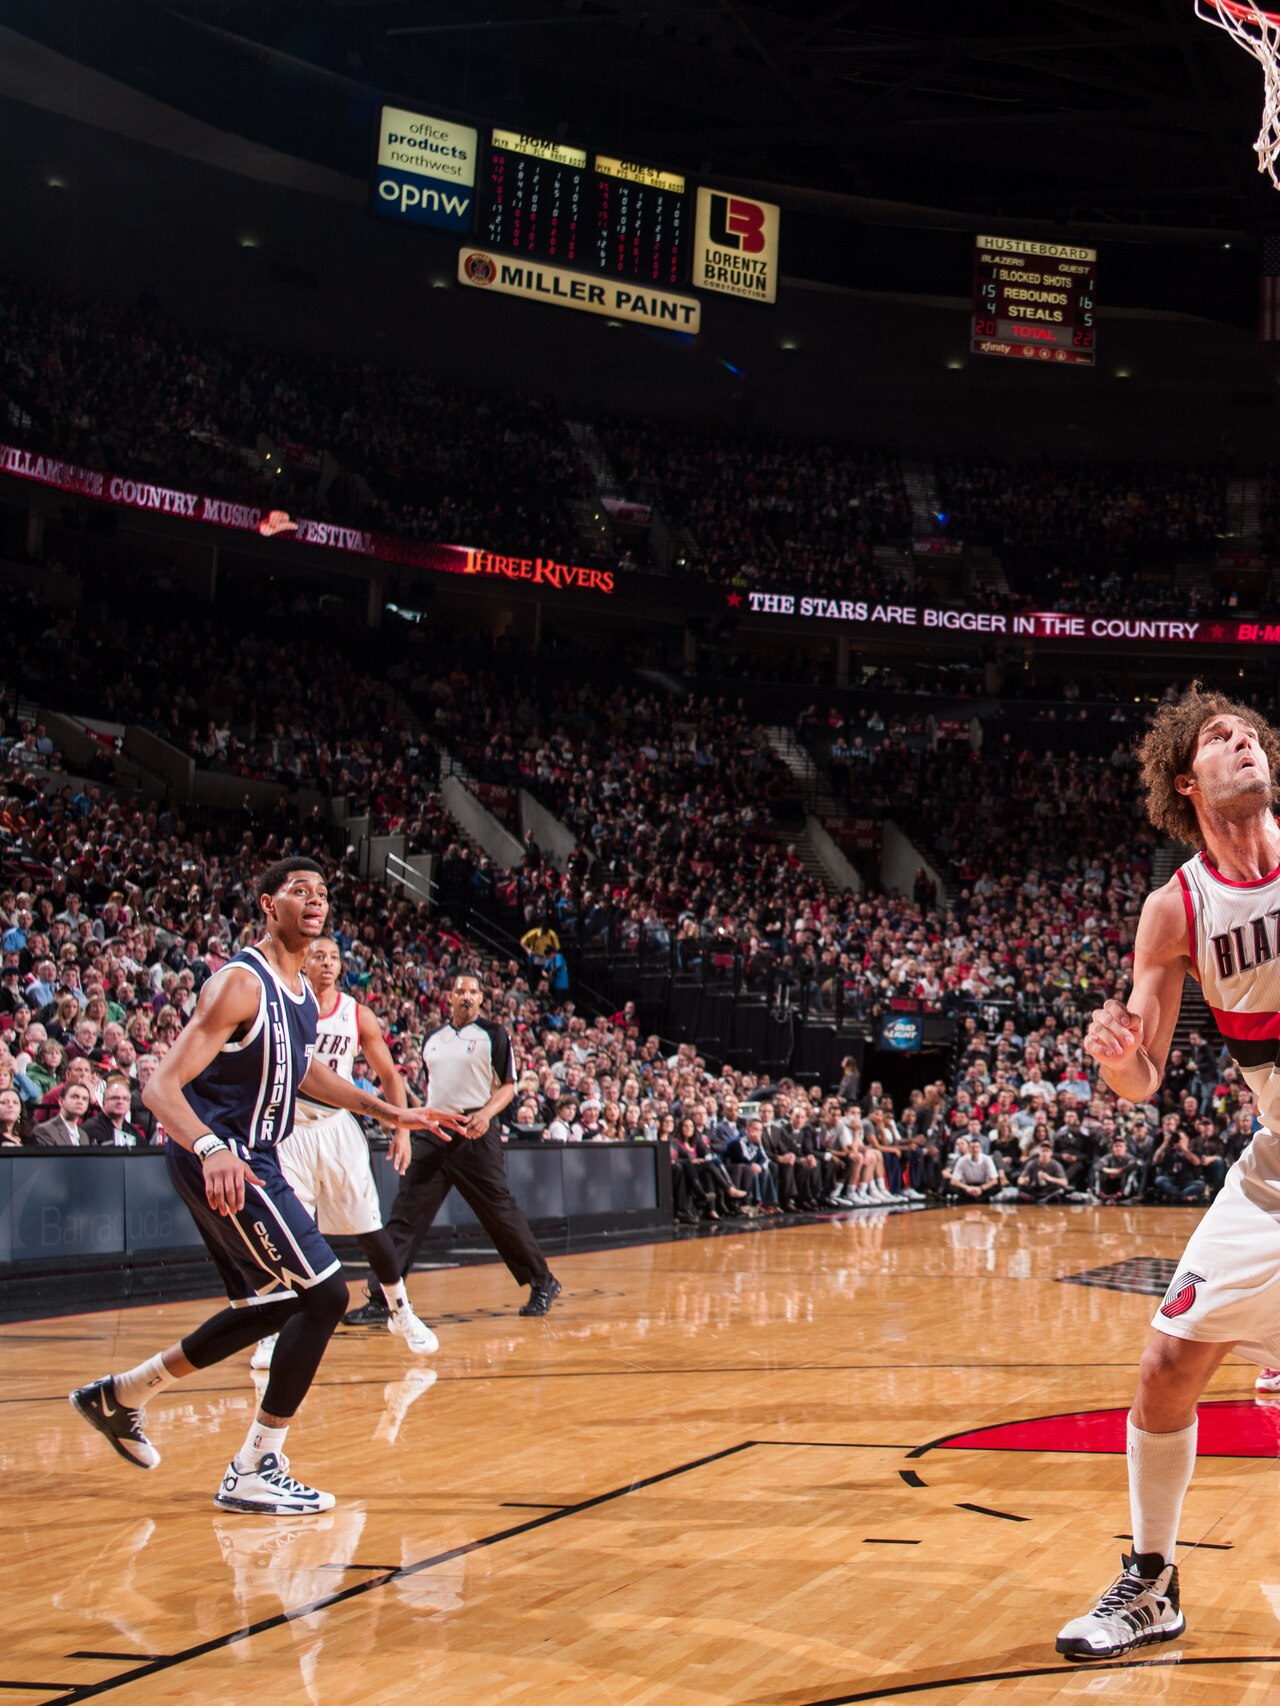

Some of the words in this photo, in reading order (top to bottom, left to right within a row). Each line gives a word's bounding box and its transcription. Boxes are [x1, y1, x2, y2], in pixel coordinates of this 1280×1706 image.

[410, 124, 448, 141] office
[520, 134, 560, 154] HOME
[388, 132, 468, 160] products
[391, 151, 463, 177] northwest
[620, 161, 660, 178] GUEST
[378, 180, 470, 217] opnw
[984, 238, 1088, 260] HUSTLEBOARD
[705, 249, 768, 276] LORENTZ
[981, 254, 1025, 266] BLAZERS
[1058, 264, 1090, 274] GUEST
[704, 264, 767, 292] BRUUN
[704, 280, 766, 298] CONSTRUCTION
[1000, 269, 1042, 284] BLOCKED
[1043, 274, 1072, 288] SHOTS
[501, 265, 606, 306] MILLER
[616, 290, 696, 324] PAINT
[982, 284, 996, 298] 15
[1004, 287, 1068, 306] REBOUNDS
[1080, 296, 1092, 310] 16
[987, 303, 996, 314] 4
[1008, 306, 1064, 322] STEALS
[1084, 314, 1092, 326] 5
[976, 320, 996, 335] 20
[1011, 324, 1057, 342] TOTAL
[1073, 332, 1093, 346] 22
[980, 342, 1012, 355] xfinity
[110, 478, 198, 517] COUNTRY
[203, 497, 262, 530] MUSIC
[464, 548, 532, 580] THREE
[532, 558, 615, 594] RIVERS
[748, 592, 795, 614] THE
[800, 597, 868, 621] STARS
[871, 604, 917, 625] ARE
[923, 608, 1007, 634] BIGGER
[1013, 616, 1035, 634] IN
[1040, 616, 1086, 636] THE
[1091, 618, 1200, 640] COUNTRY
[260, 1001, 286, 1141] THUNDER
[40, 1202, 172, 1246] Barracuda
[252, 1220, 282, 1262] OKC
